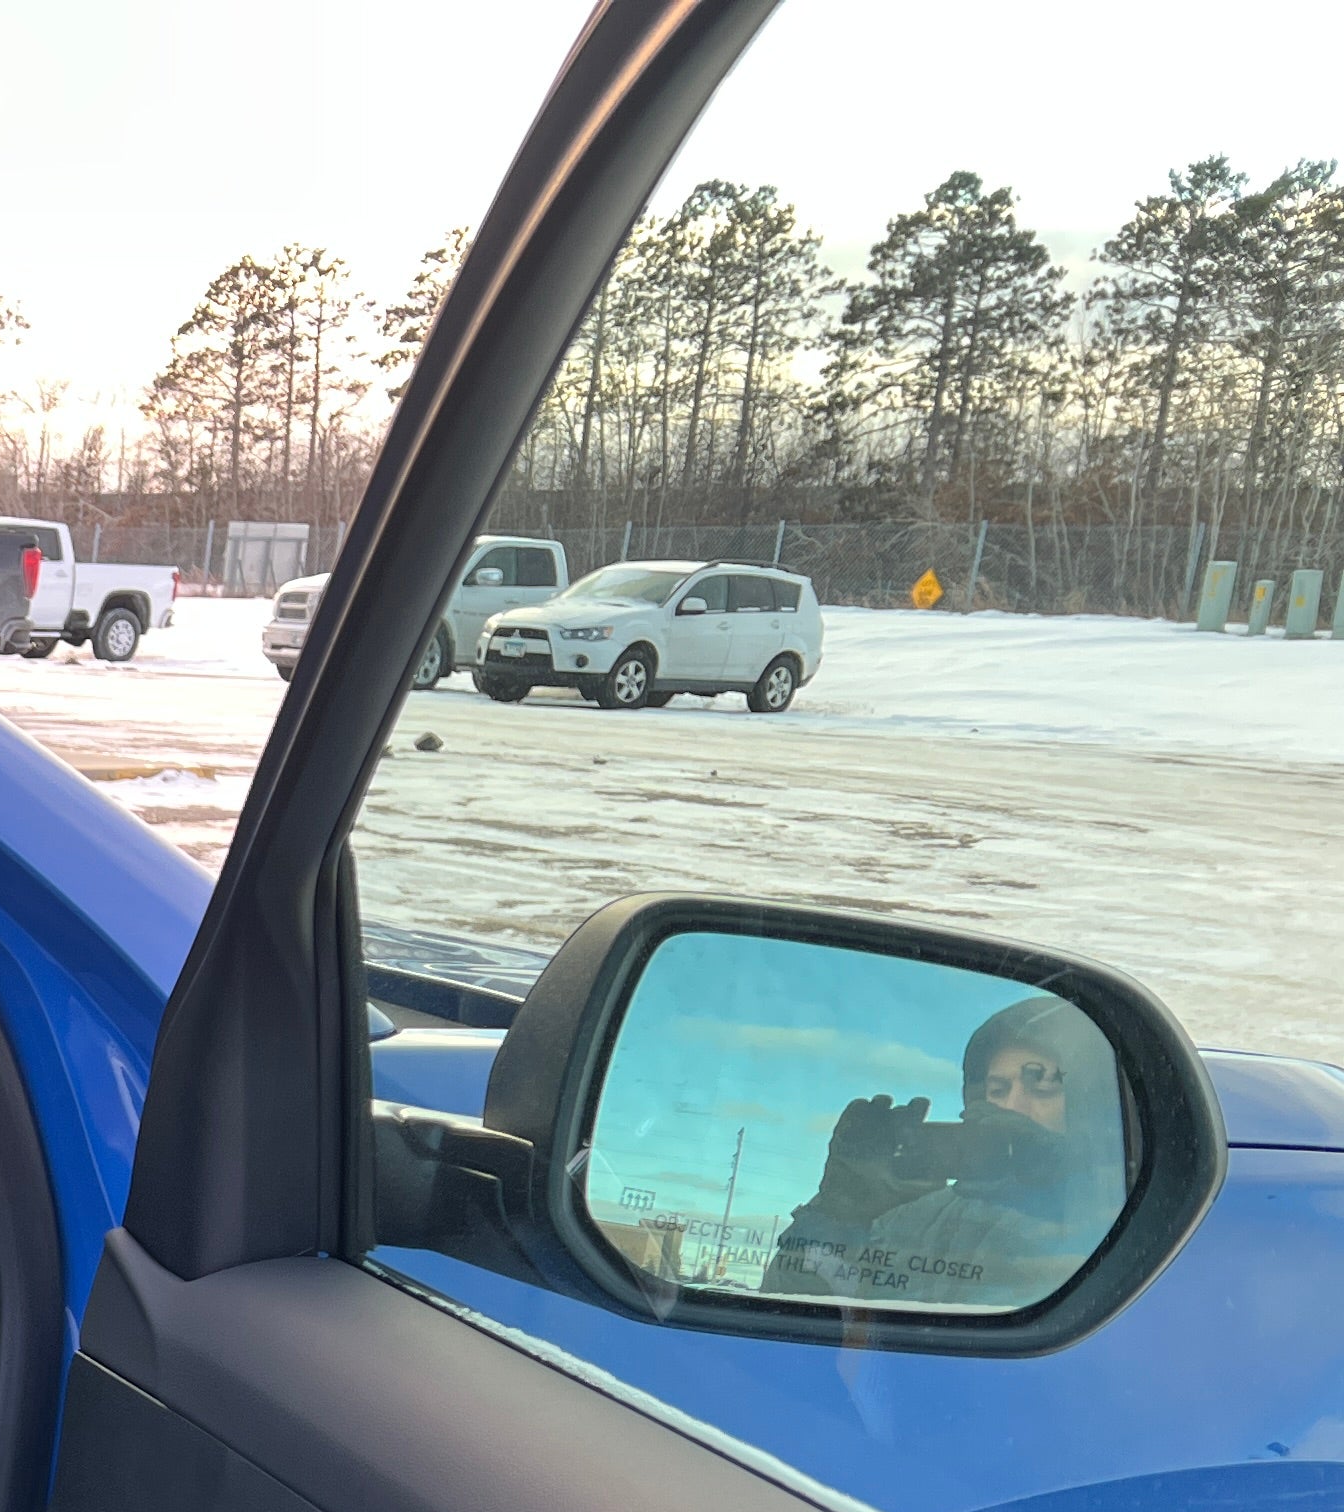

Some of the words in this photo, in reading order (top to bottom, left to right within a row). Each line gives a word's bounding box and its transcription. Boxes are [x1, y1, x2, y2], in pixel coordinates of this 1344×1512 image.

[654, 1213, 734, 1241] OBJECTS
[746, 1228, 766, 1246] IN
[778, 1235, 847, 1259] MIRROR
[858, 1248, 897, 1268] ARE
[908, 1255, 984, 1281] CLOSER
[718, 1244, 763, 1267] THAN
[775, 1254, 823, 1276] THEY
[834, 1262, 910, 1291] APPEAR
